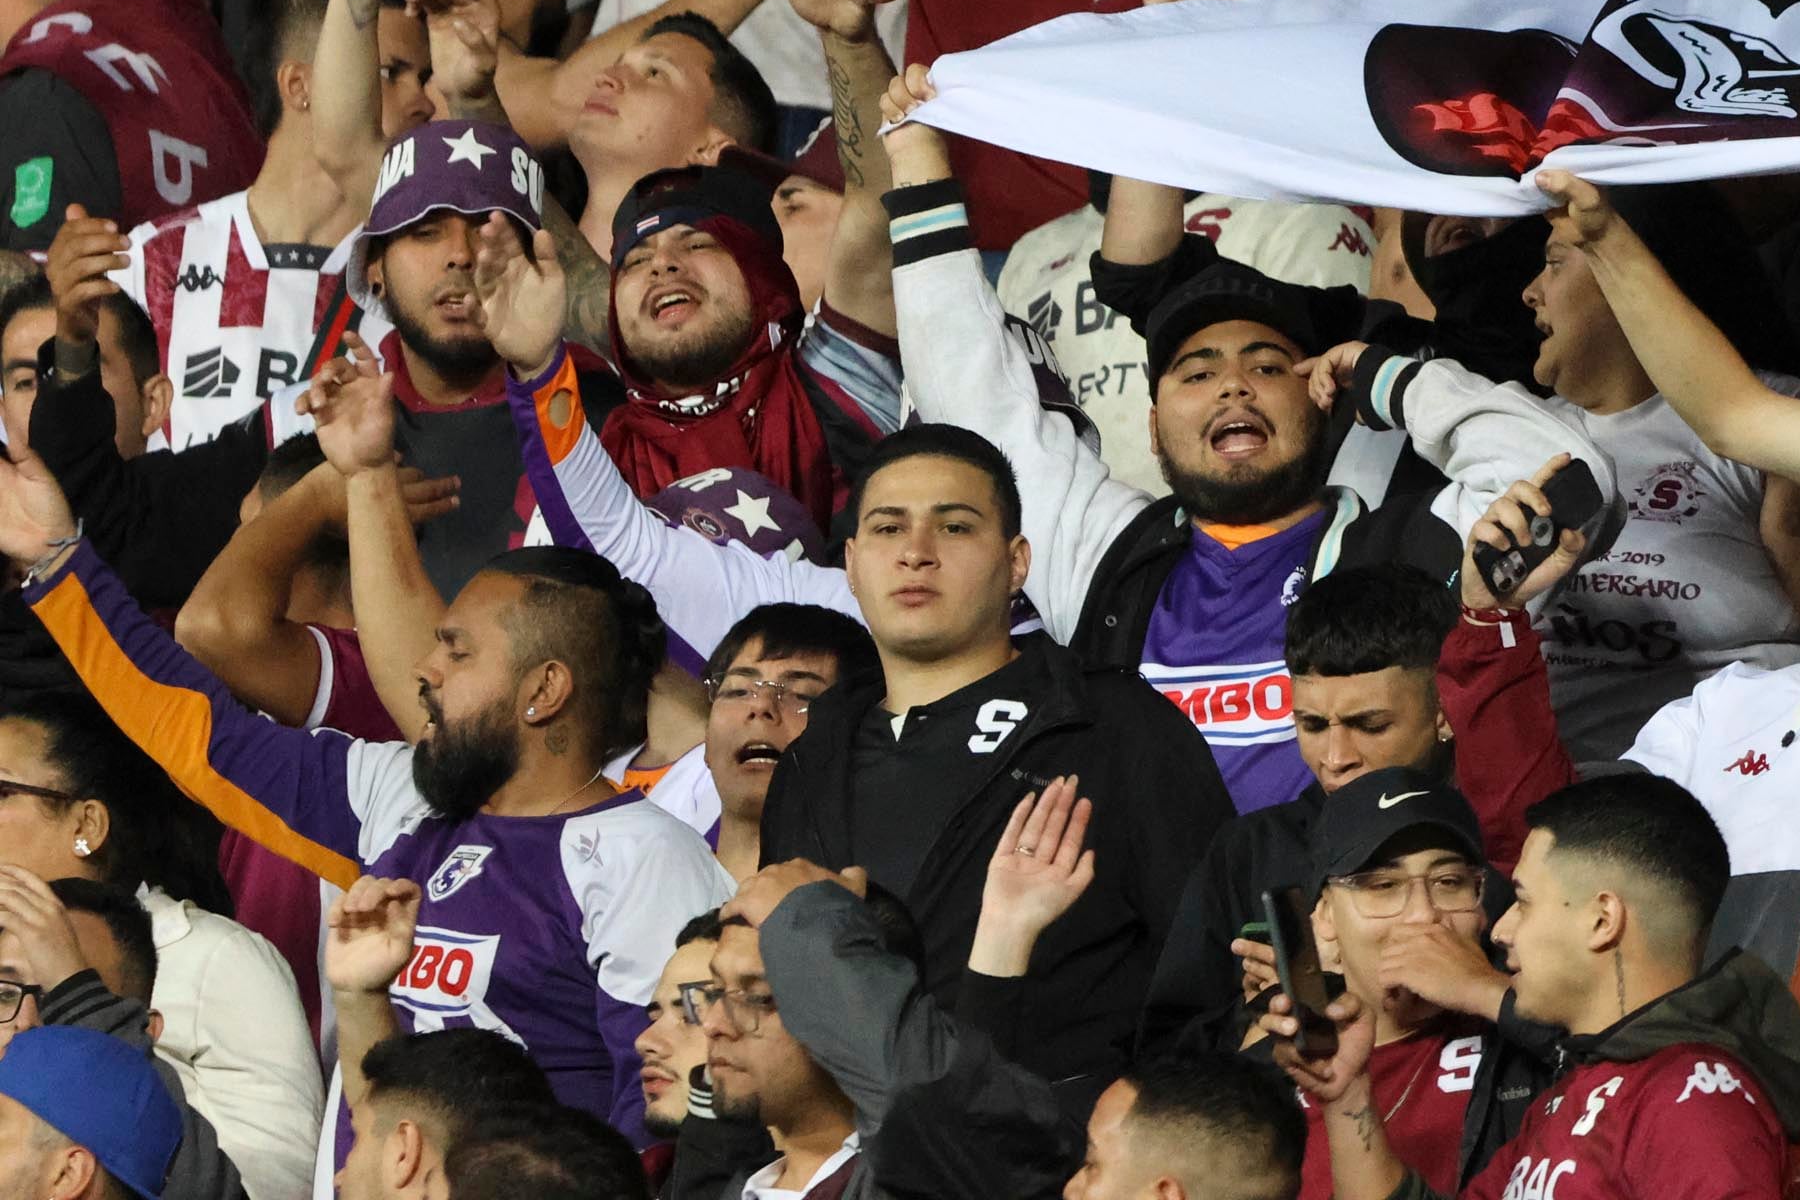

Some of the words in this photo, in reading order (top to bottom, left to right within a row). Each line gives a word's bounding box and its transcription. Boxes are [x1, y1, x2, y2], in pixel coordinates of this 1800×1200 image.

[1647, 480, 1684, 511] S
[967, 698, 1029, 754] S
[1437, 1035, 1483, 1094] S
[1571, 1075, 1625, 1137] S
[1502, 1155, 1577, 1200] BAC
